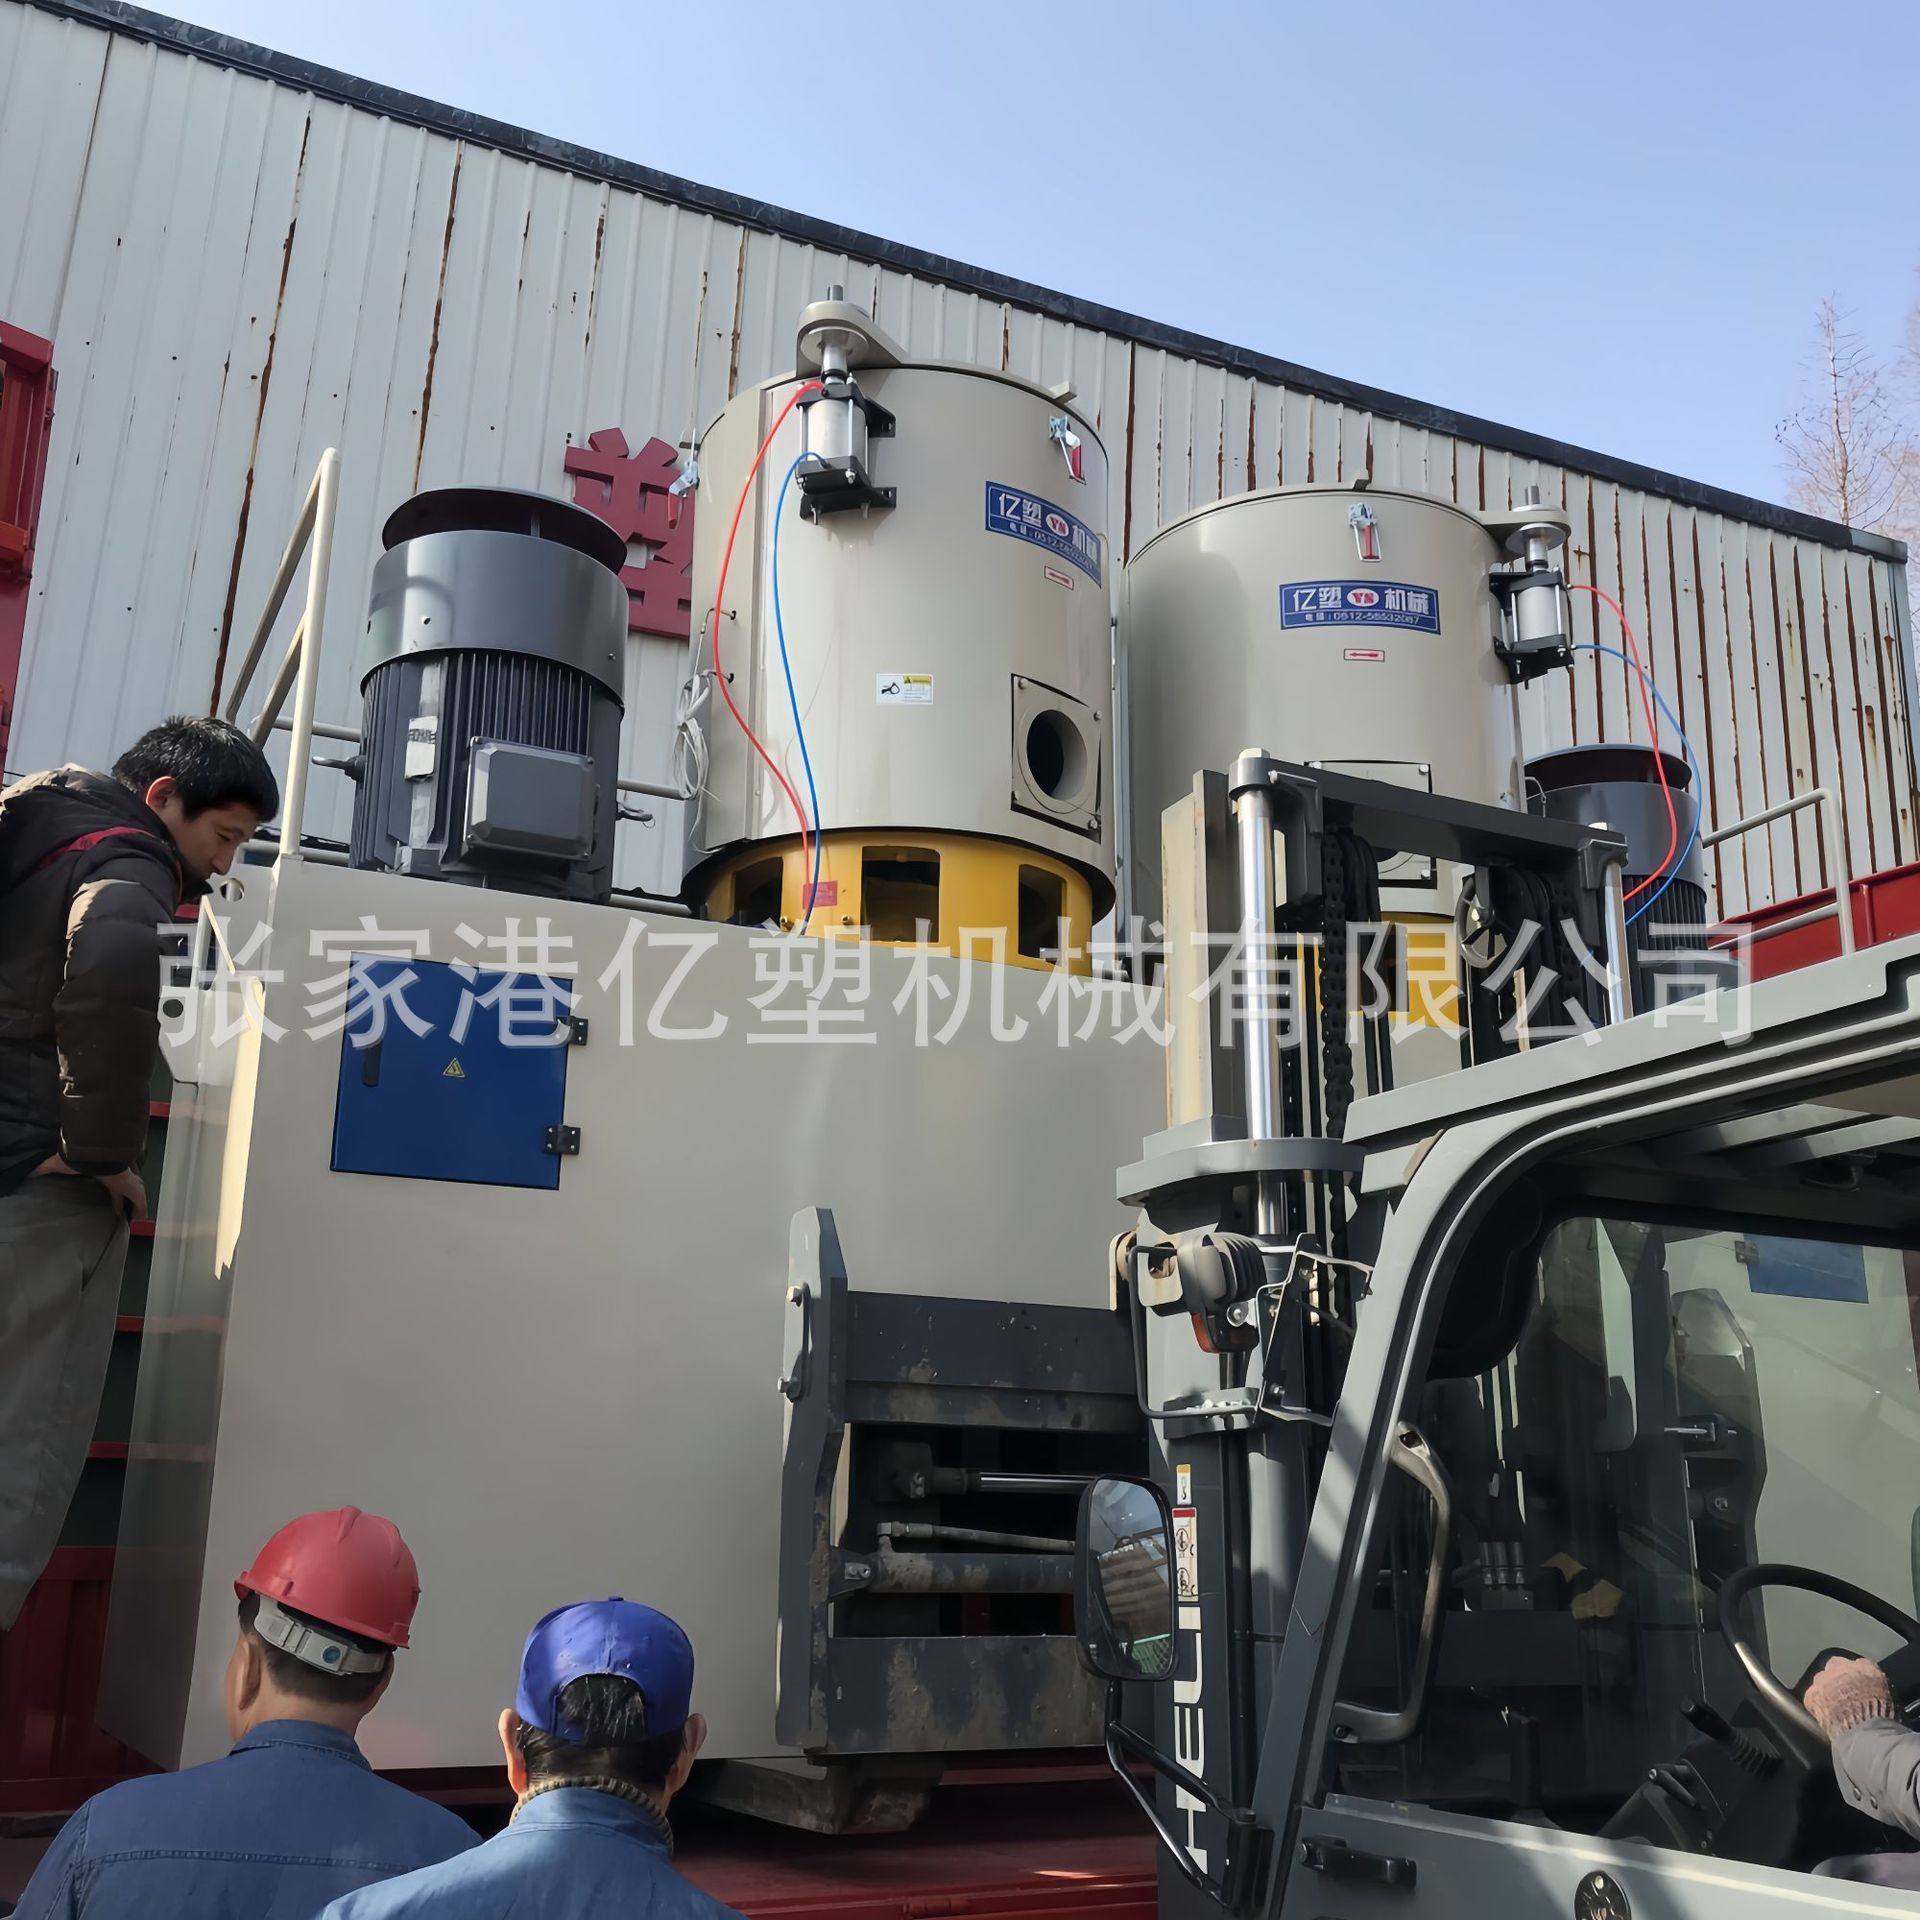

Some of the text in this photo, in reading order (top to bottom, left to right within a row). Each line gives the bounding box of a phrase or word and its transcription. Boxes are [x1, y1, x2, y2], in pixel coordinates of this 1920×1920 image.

[998, 492, 1042, 528] 亿塑
[1292, 586, 1342, 612] 亿塑
[1384, 587, 1430, 615] 机械
[1172, 1606, 1208, 1875] HELI
